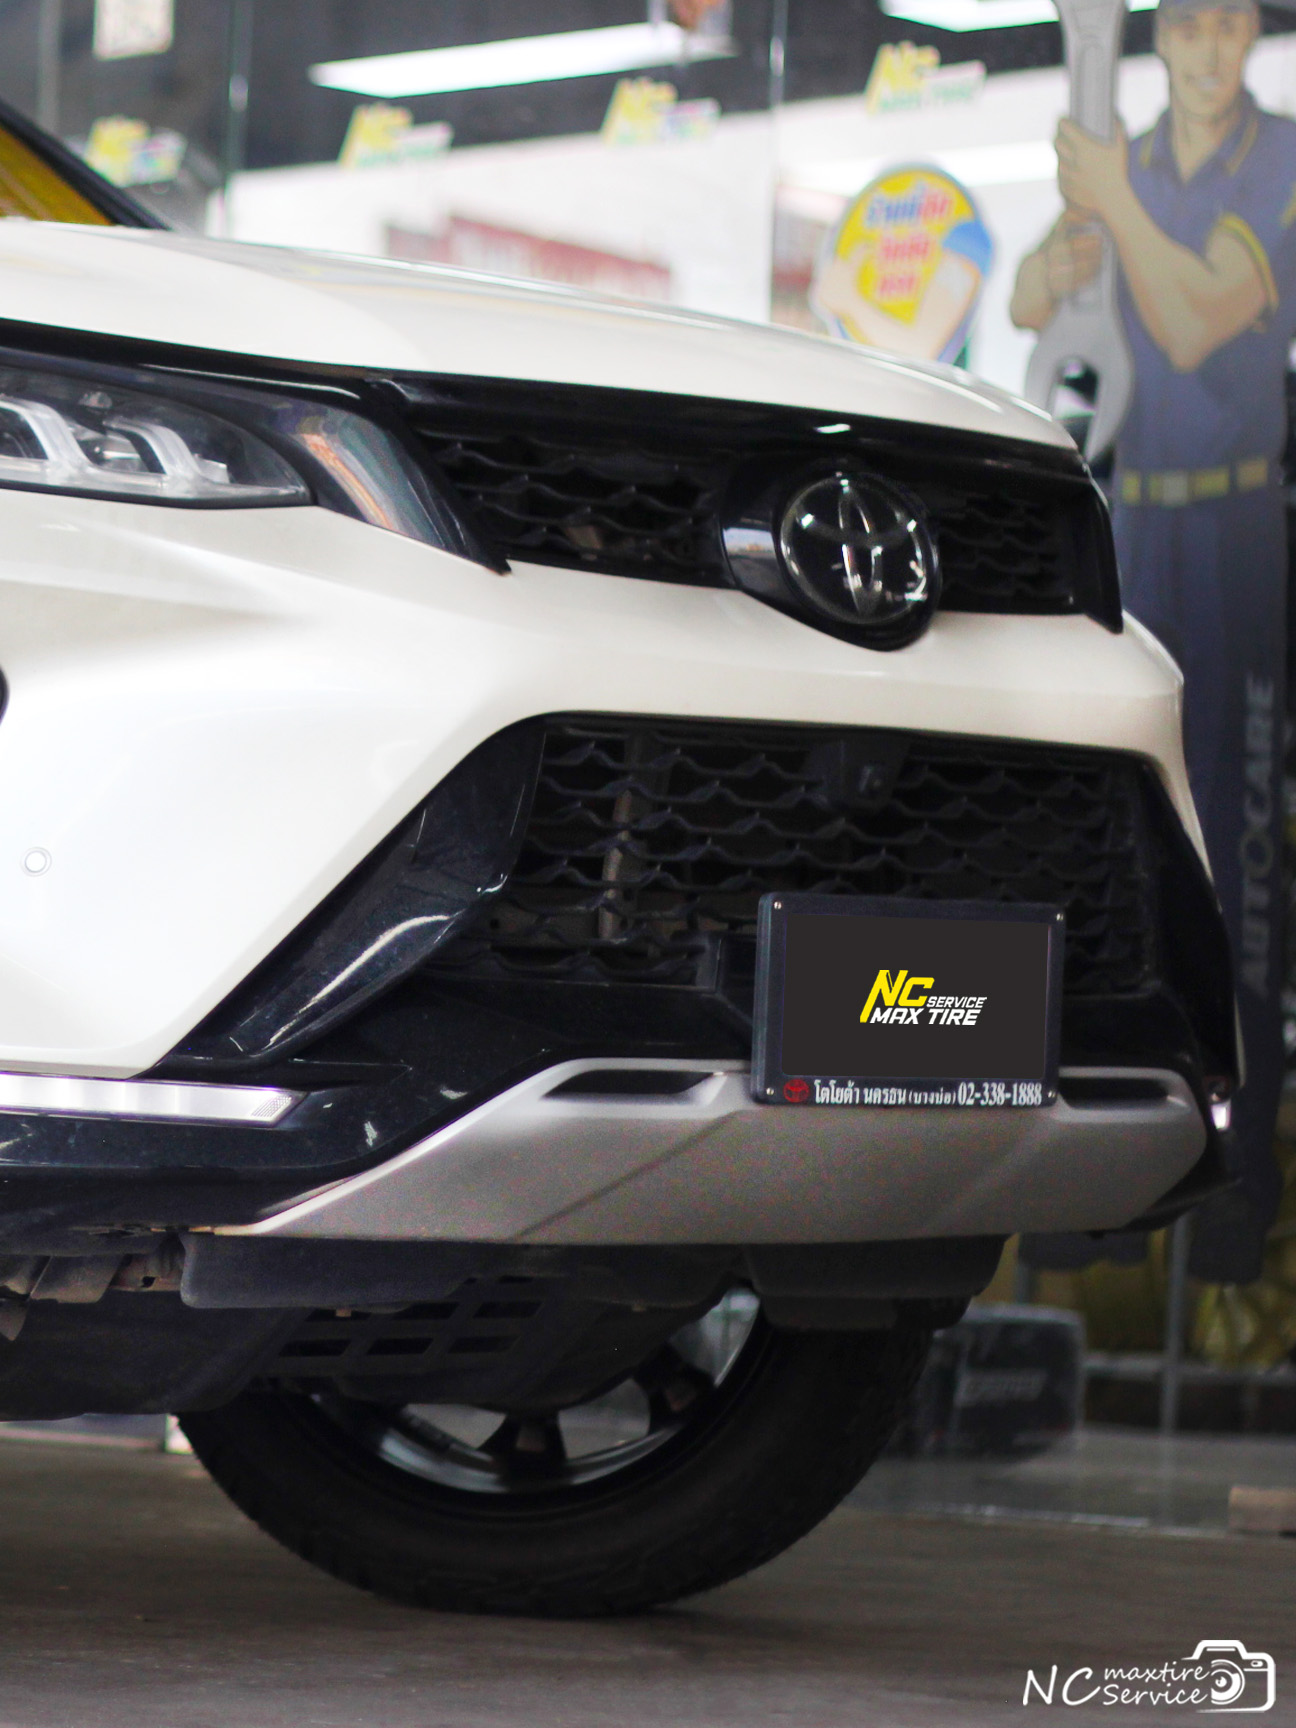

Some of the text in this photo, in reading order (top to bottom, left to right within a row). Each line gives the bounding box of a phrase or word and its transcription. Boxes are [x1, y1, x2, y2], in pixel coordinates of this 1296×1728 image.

[813, 1079, 860, 1104] โตโยต้า
[957, 1081, 1043, 1106] 02-338-1888
